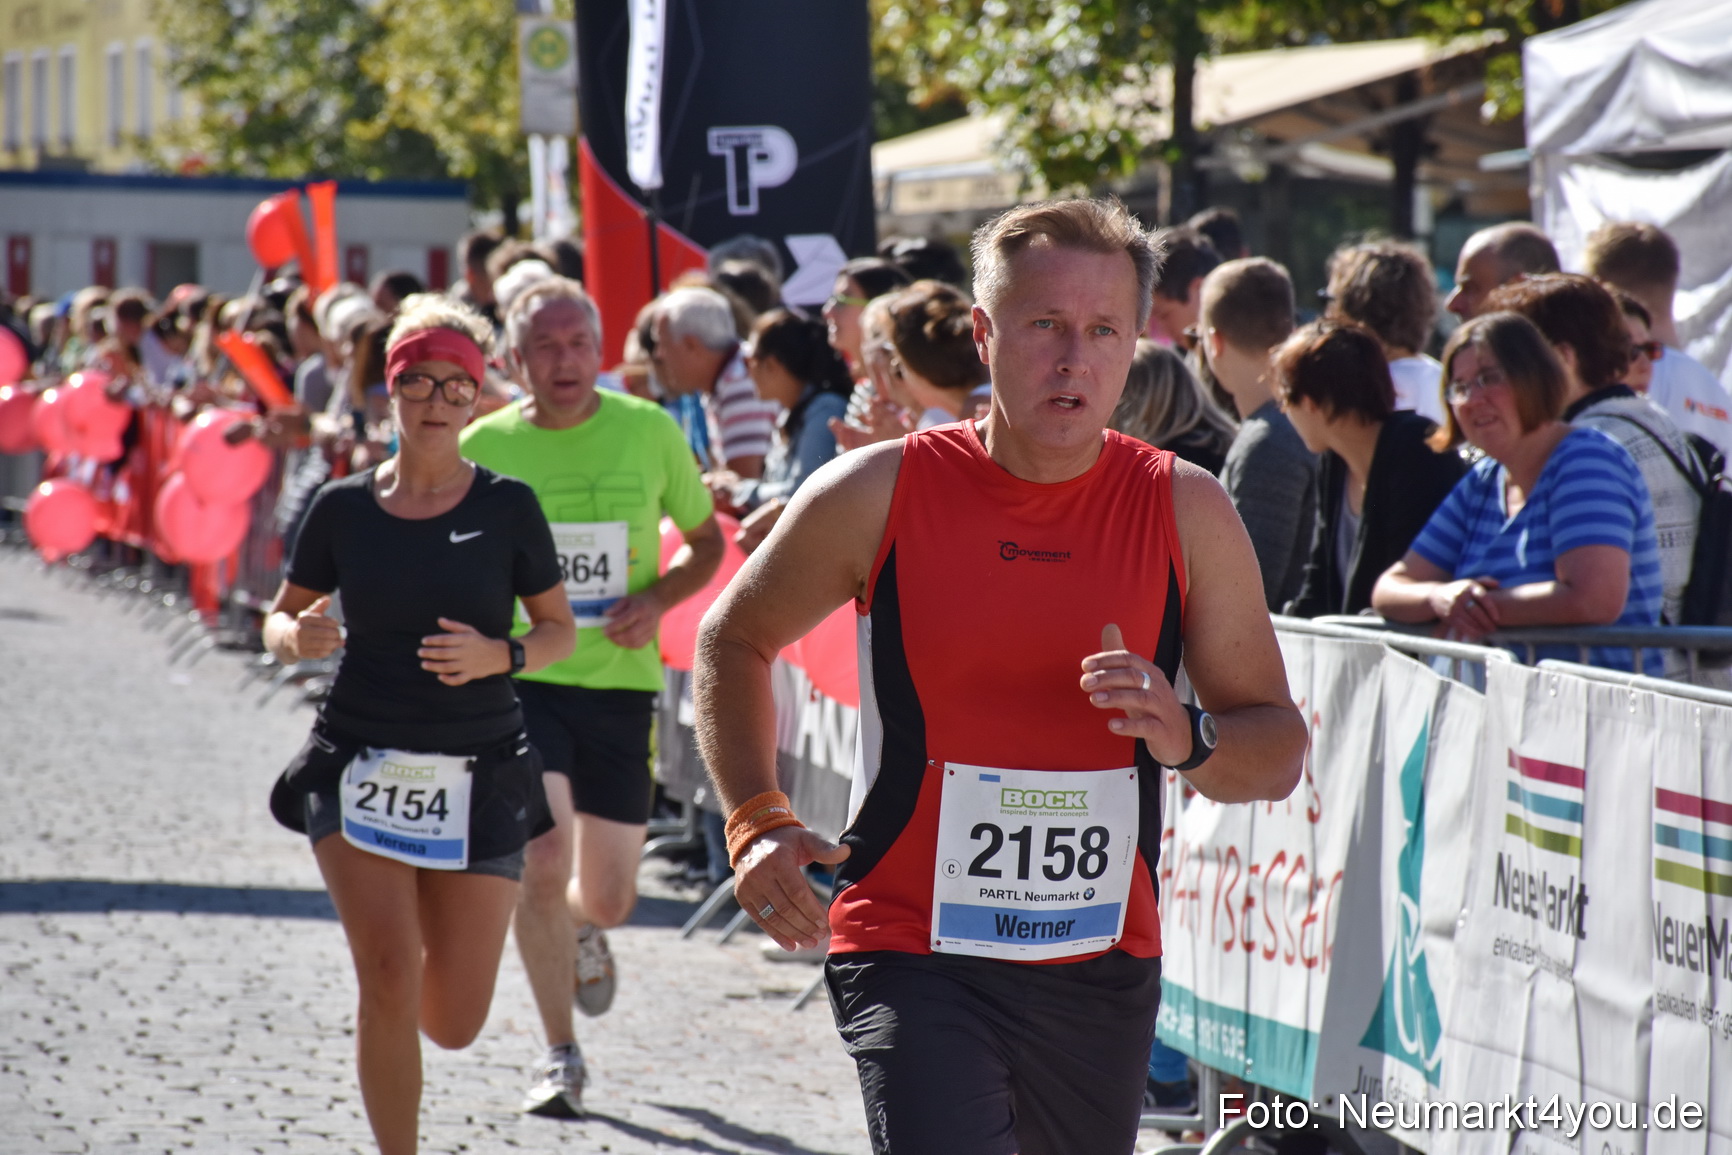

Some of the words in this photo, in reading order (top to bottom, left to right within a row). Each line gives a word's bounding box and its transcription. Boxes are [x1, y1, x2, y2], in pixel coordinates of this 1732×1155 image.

[1007, 547, 1072, 560] movement
[355, 781, 449, 823] 2154
[1001, 787, 1089, 810] BOCK
[1000, 808, 1028, 817] inspired
[1060, 810, 1089, 818] concepts
[374, 831, 427, 855] Verena
[967, 822, 1111, 882] 2158
[979, 888, 1022, 901] PARTL
[1024, 891, 1080, 902] Neumarkt
[995, 912, 1076, 939] Werner
